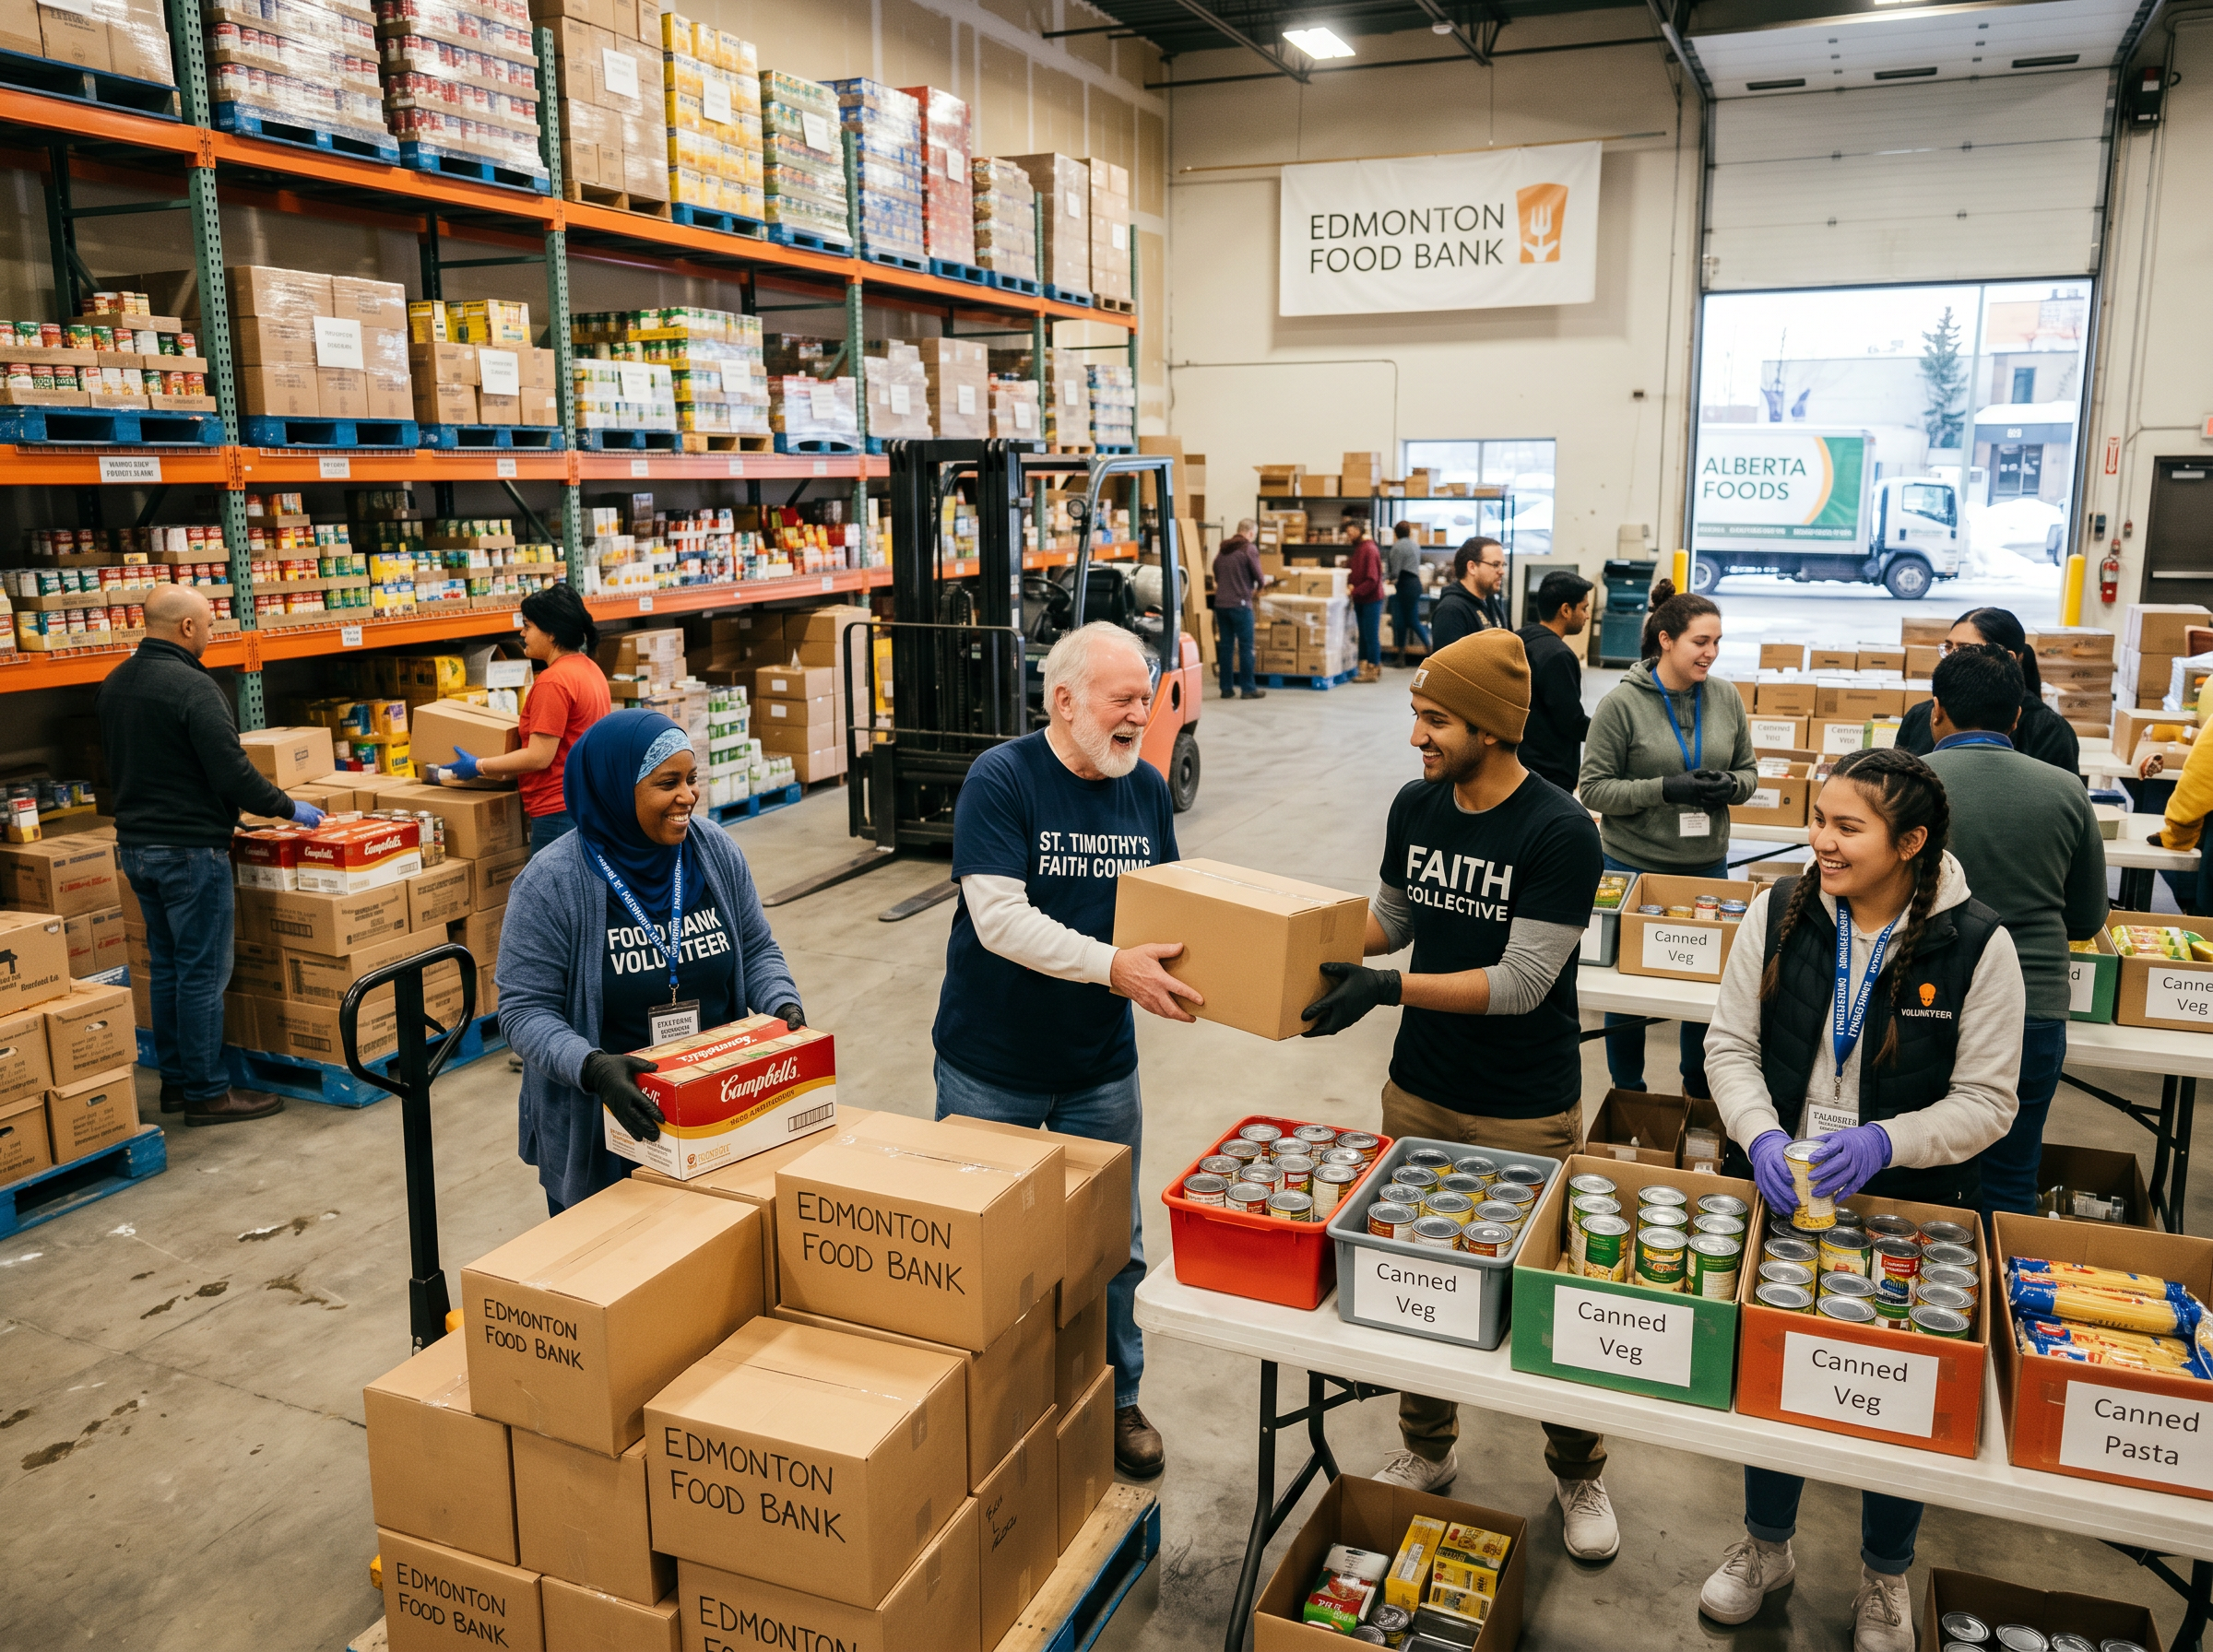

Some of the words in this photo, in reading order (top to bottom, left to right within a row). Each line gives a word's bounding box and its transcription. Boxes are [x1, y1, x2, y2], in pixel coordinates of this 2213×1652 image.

[1310, 203, 1504, 241] EDMONTON
[1310, 245, 1402, 274] FOOD
[1414, 238, 1504, 269] BANK
[1703, 457, 1806, 476] ALBERTA
[1703, 481, 1789, 501] FOODS
[1039, 831, 1065, 852] ST.
[1069, 832, 1151, 856] TIMOTHY'S
[1038, 855, 1088, 878] FAITH
[1406, 844, 1513, 901] FAITH
[1406, 885, 1509, 922] COLLECTIVE
[1655, 930, 1707, 946] Canned
[1668, 950, 1694, 965] Veg
[2163, 977, 2213, 993] Canne
[2177, 997, 2208, 1015] Veg
[798, 1192, 952, 1249] EDMONTON
[802, 1233, 873, 1272] FOOD
[888, 1250, 965, 1295] BANK
[1377, 1262, 1457, 1293] Canned
[483, 1299, 577, 1342] EDMONTON
[1395, 1295, 1436, 1323] Veg
[1578, 1302, 1667, 1333] Canned
[485, 1326, 528, 1353] FOOD
[536, 1339, 585, 1372] BANK
[1599, 1336, 1643, 1365] Veg
[1812, 1348, 1909, 1383] Canned
[1833, 1385, 1882, 1416] Veg
[2094, 1398, 2200, 1434] Canned
[665, 1427, 834, 1495] EDMONTON
[2105, 1435, 2179, 1466] Pasta
[670, 1470, 744, 1516] FOOD
[761, 1493, 846, 1544] BANK
[396, 1562, 505, 1618] EDMONTON
[398, 1592, 445, 1625] FOOD
[454, 1611, 509, 1648] BANK
